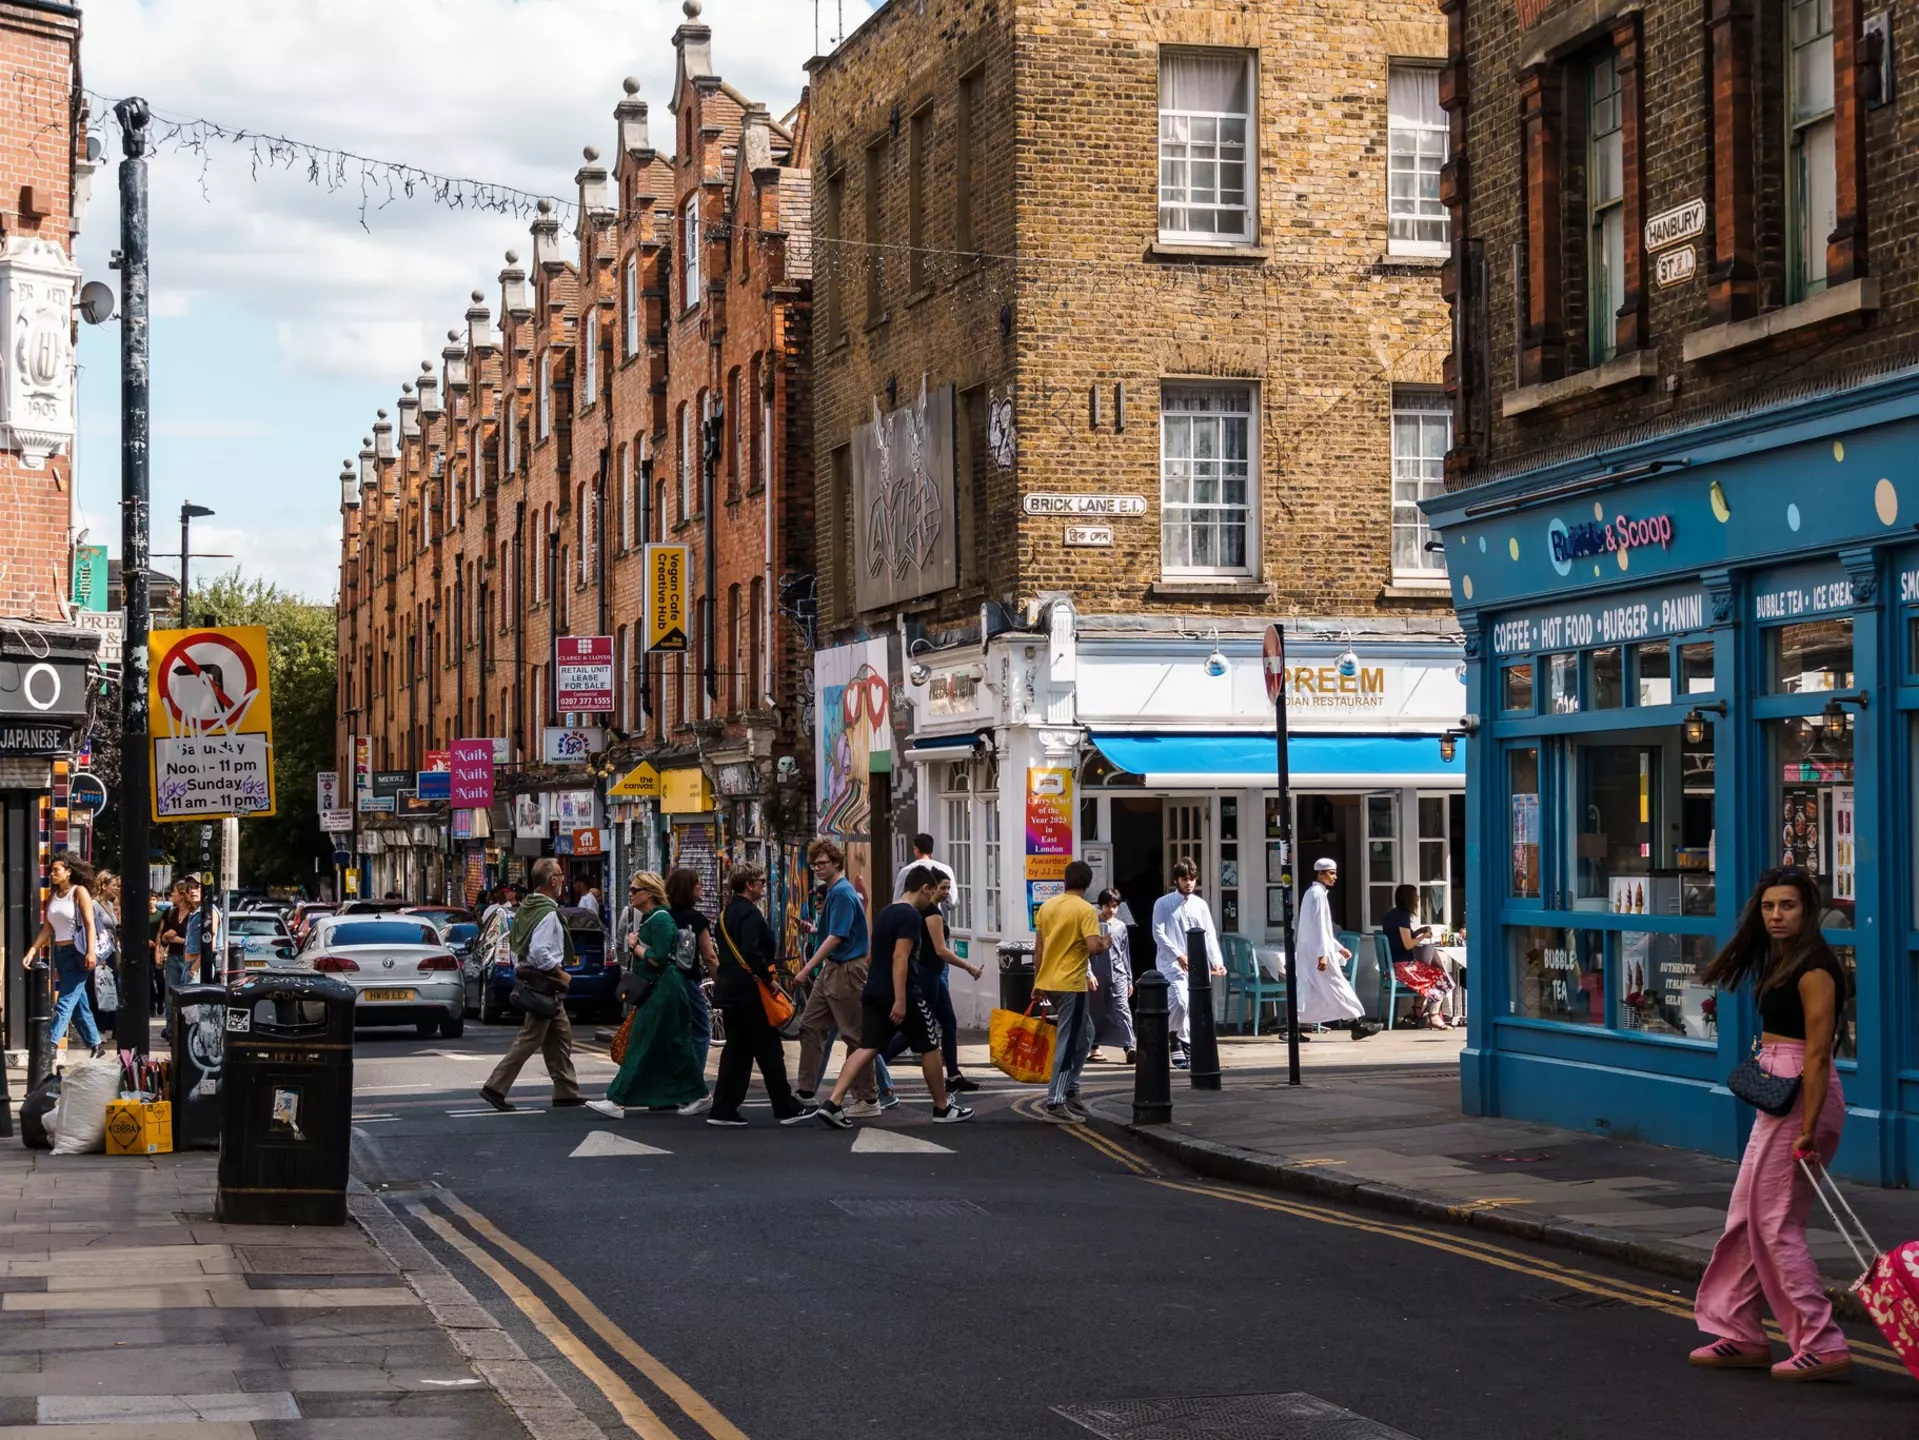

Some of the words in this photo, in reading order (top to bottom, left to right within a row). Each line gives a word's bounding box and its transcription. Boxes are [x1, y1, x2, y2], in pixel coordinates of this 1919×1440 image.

[1648, 207, 1700, 242] HANBURY
[1030, 497, 1073, 511] BRICK
[1078, 498, 1115, 512] LANE
[1616, 514, 1671, 550] Scoop
[658, 553, 668, 604] Creative
[668, 553, 679, 591] Vegan
[670, 593, 679, 621] Cafe
[1756, 592, 1785, 619] BUBBLE
[1787, 589, 1803, 615] TEA
[1813, 585, 1827, 611] ICE
[1828, 581, 1853, 609] CREA
[658, 606, 667, 630] Hub
[1493, 619, 1530, 653] COFFEE
[1541, 616, 1562, 648] HOT
[1565, 613, 1593, 646] FOOD
[1603, 604, 1648, 642] BURGER
[1662, 594, 1702, 633] PANINI
[106, 631, 120, 645] &
[560, 697, 577, 705] 0207
[1313, 696, 1384, 706] RESTAURANT
[0, 729, 61, 749] JAPANESE
[455, 748, 488, 762] Nails
[219, 760, 230, 772] 11
[234, 760, 257, 774] pm
[455, 767, 488, 781] Nails
[187, 777, 242, 791] Sunday
[456, 786, 488, 800] Nails
[171, 797, 181, 809] 11
[185, 797, 207, 808] am
[220, 794, 231, 806] 11
[235, 795, 257, 809] pm
[1028, 796, 1050, 807] Curry
[1052, 796, 1070, 805] Chef
[1038, 806, 1047, 814] of
[1048, 806, 1059, 814] the
[1031, 816, 1048, 824] Year
[1050, 816, 1067, 824] 2023
[1045, 825, 1053, 833] in
[1041, 835, 1058, 843] East
[1035, 845, 1064, 853] London
[1031, 857, 1067, 865] Awarded
[1028, 867, 1038, 876] by
[1033, 883, 1064, 894] Google
[1544, 948, 1575, 970] BUBBLE
[1660, 962, 1697, 974] AUTHENTIC
[1552, 979, 1567, 1000] TEA
